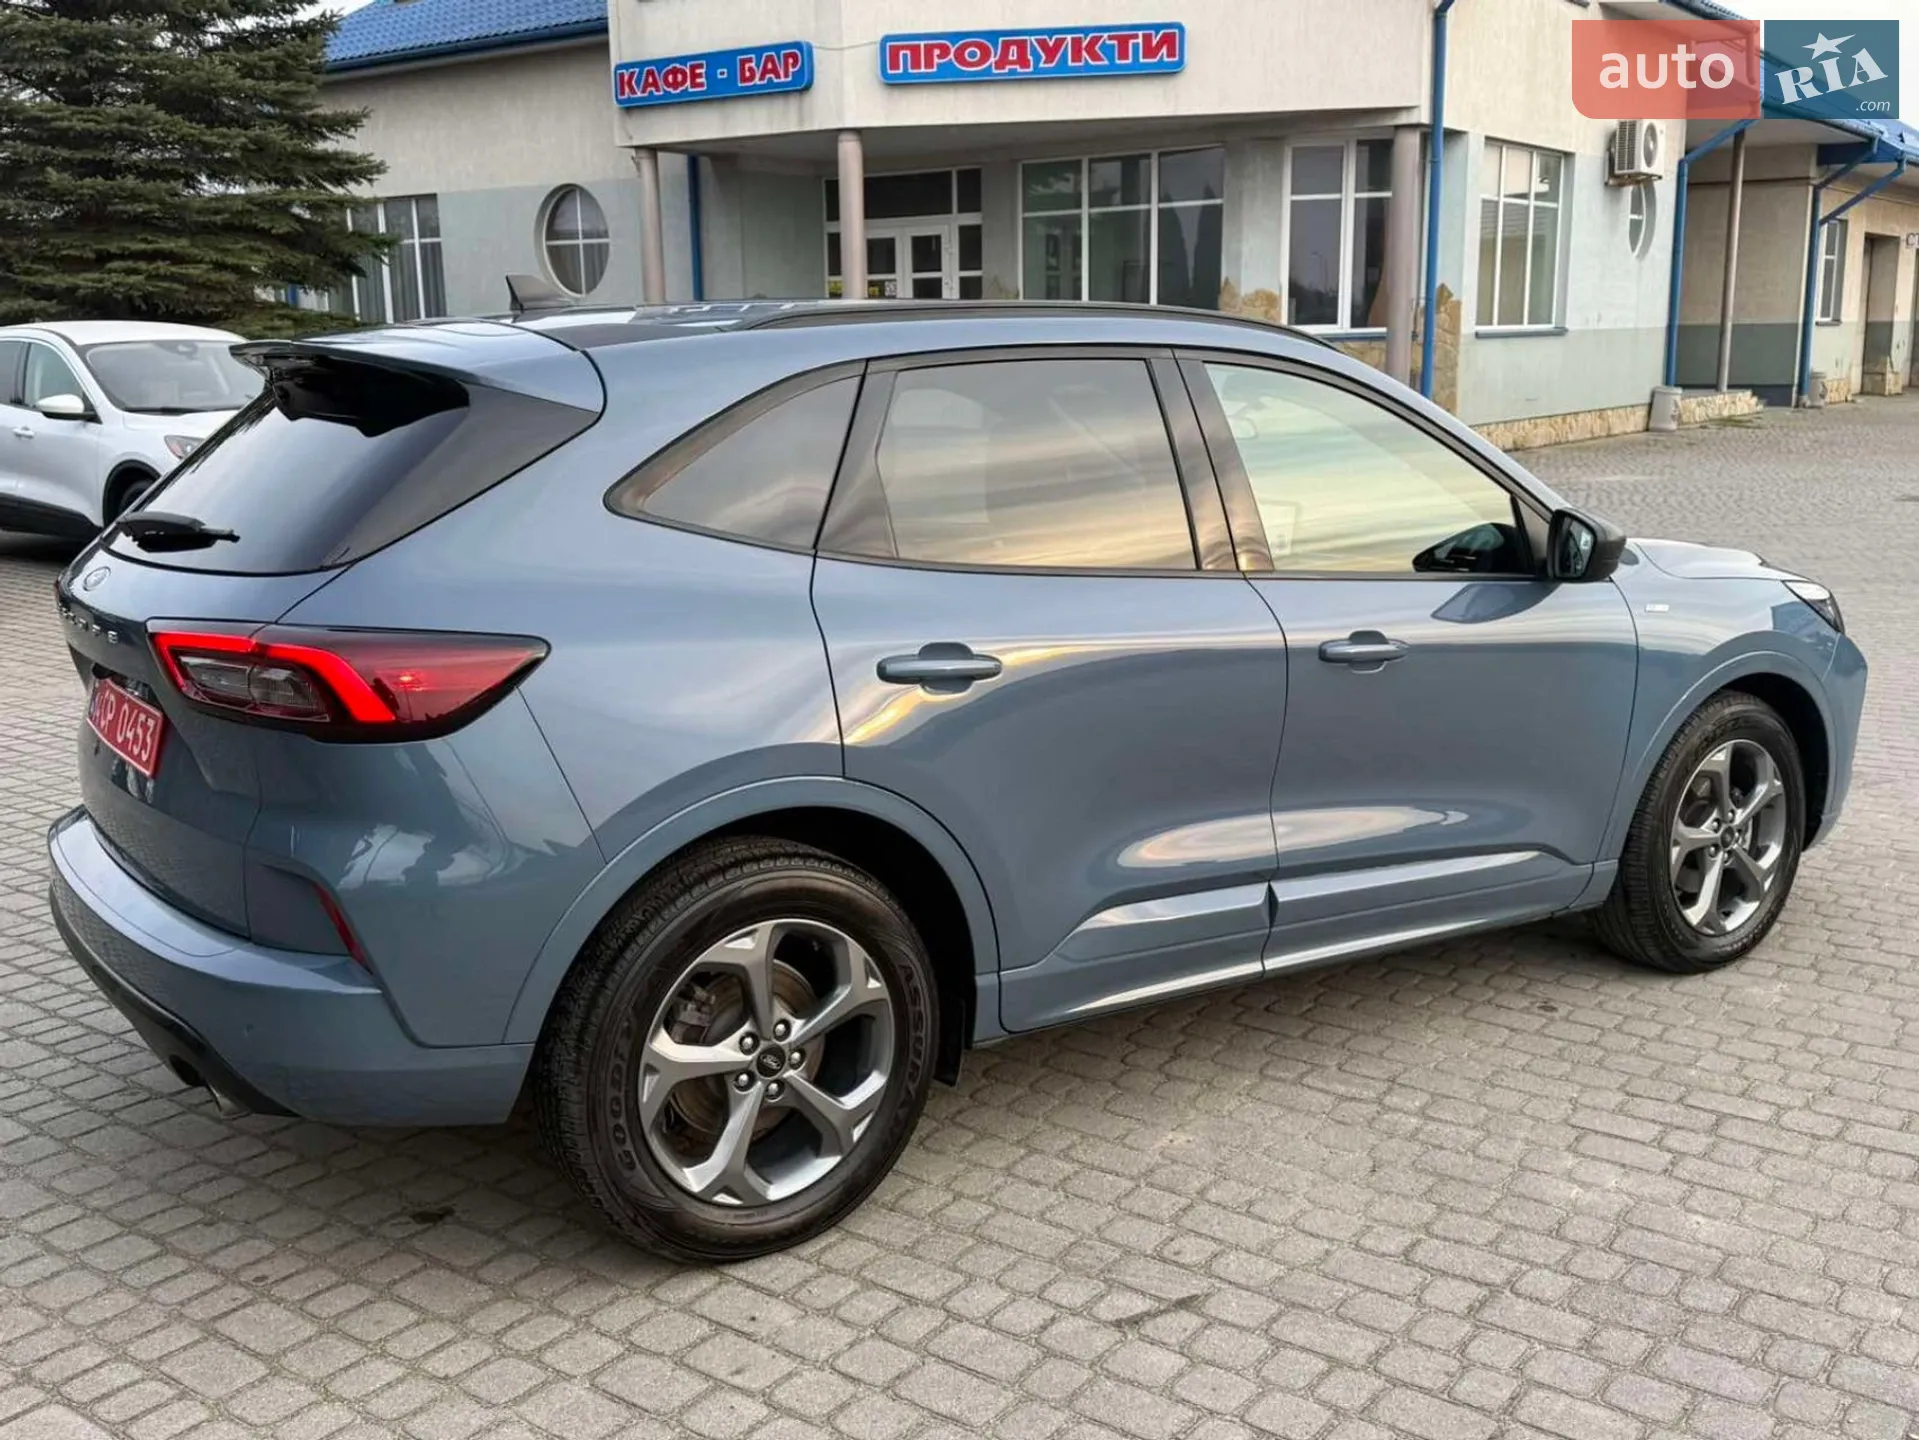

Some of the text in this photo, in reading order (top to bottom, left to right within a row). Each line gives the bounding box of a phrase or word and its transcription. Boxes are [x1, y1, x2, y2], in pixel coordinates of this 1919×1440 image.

[617, 61, 706, 99] КАФЕ
[737, 49, 800, 88] БАР
[886, 30, 1179, 73] ПРОДУКТИ
